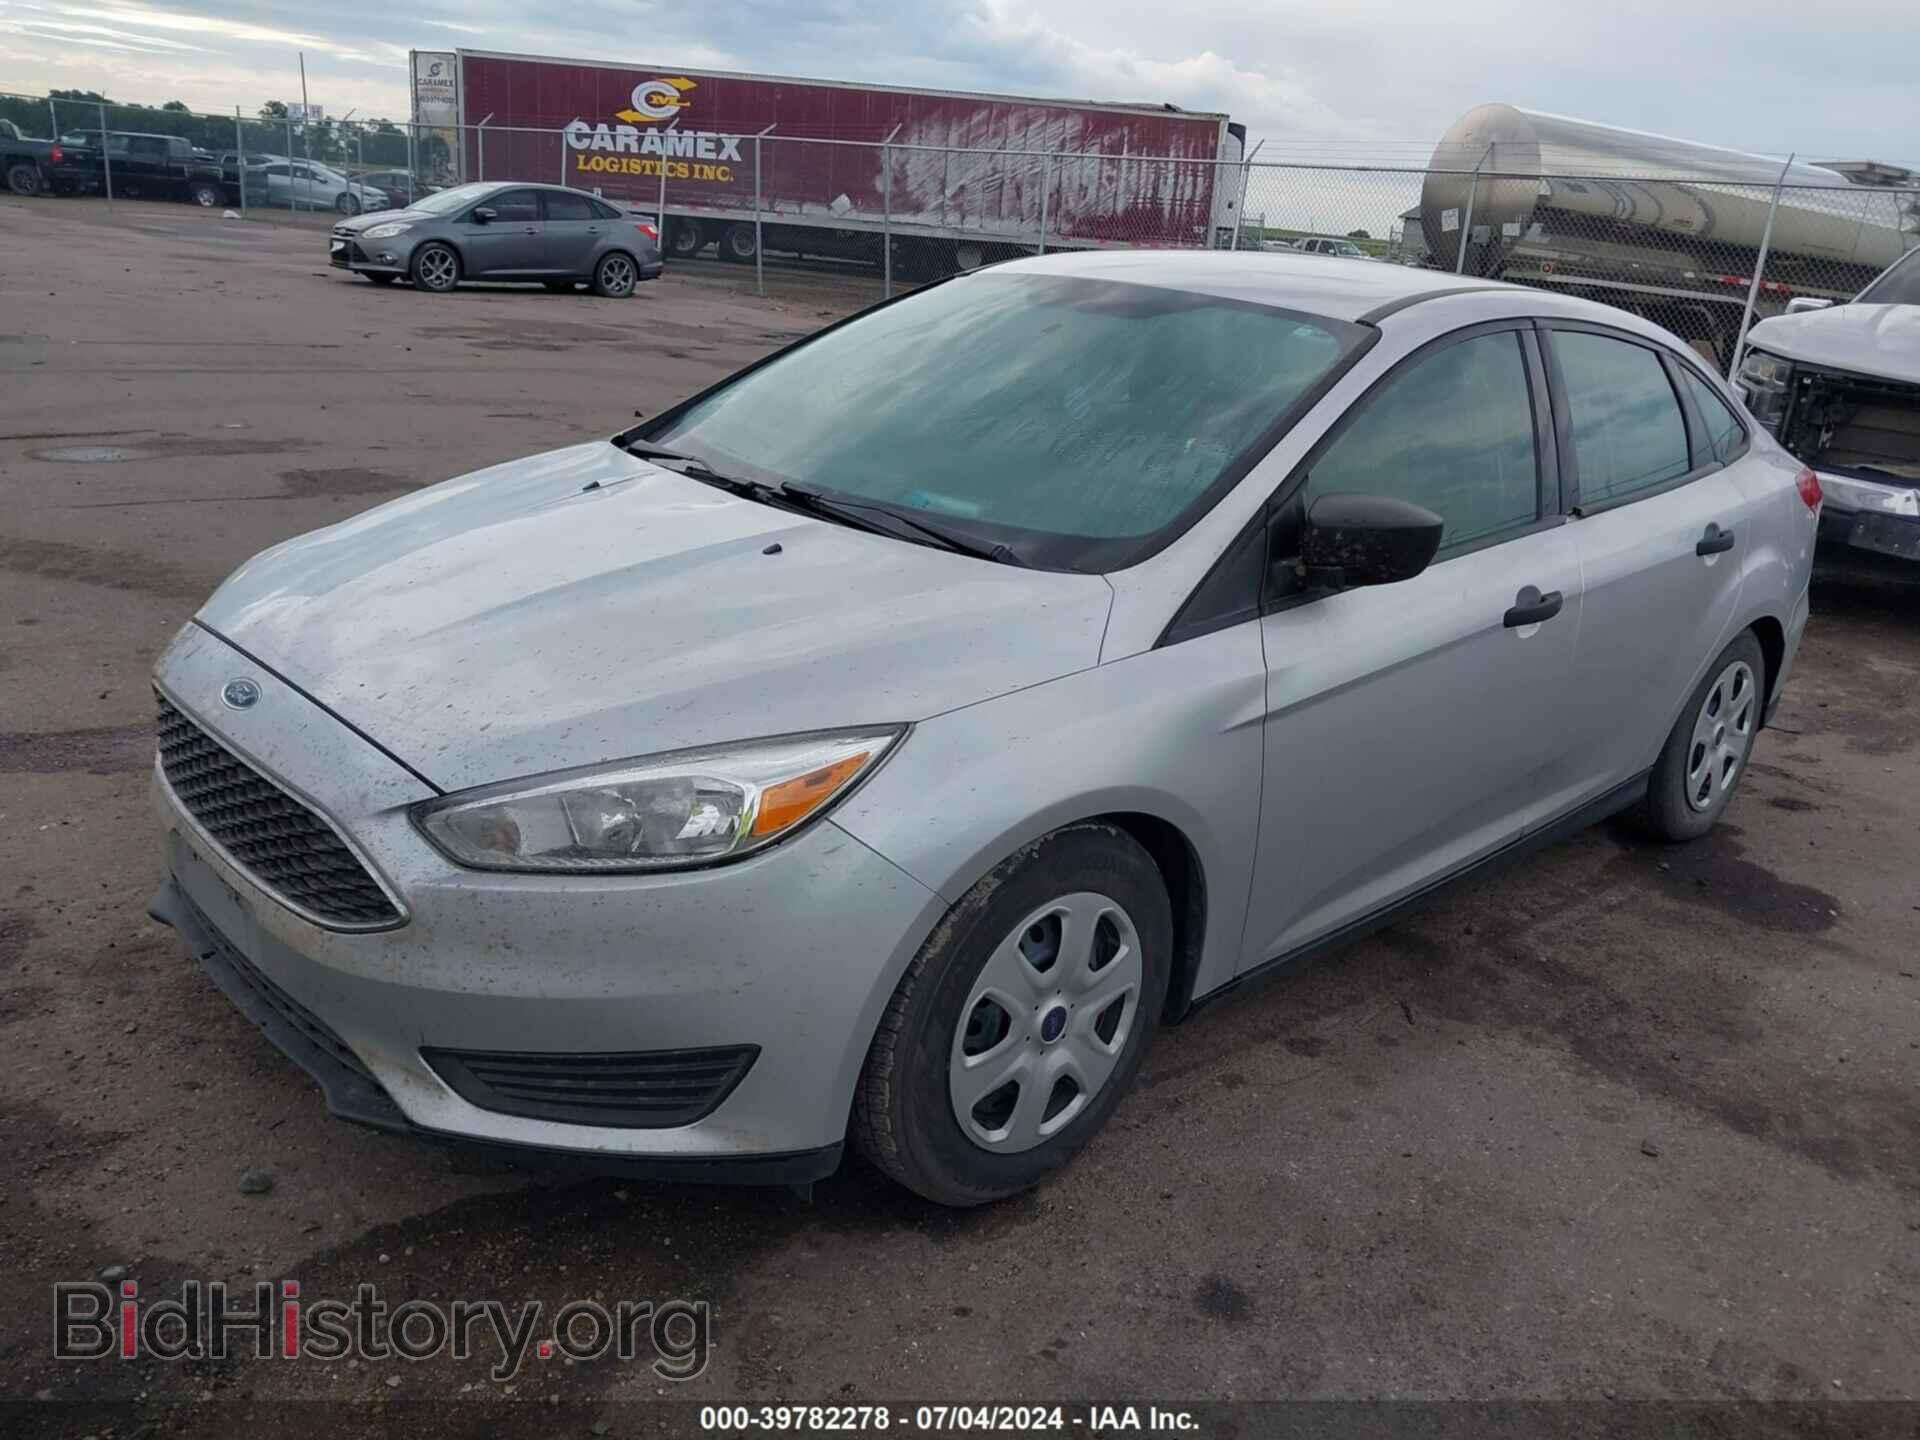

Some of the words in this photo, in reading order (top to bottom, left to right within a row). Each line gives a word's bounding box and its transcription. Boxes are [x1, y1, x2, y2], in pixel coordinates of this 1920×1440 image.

[566, 121, 742, 161] CARAMEX
[576, 154, 689, 179] LOGISTICS
[693, 164, 735, 182] INC.
